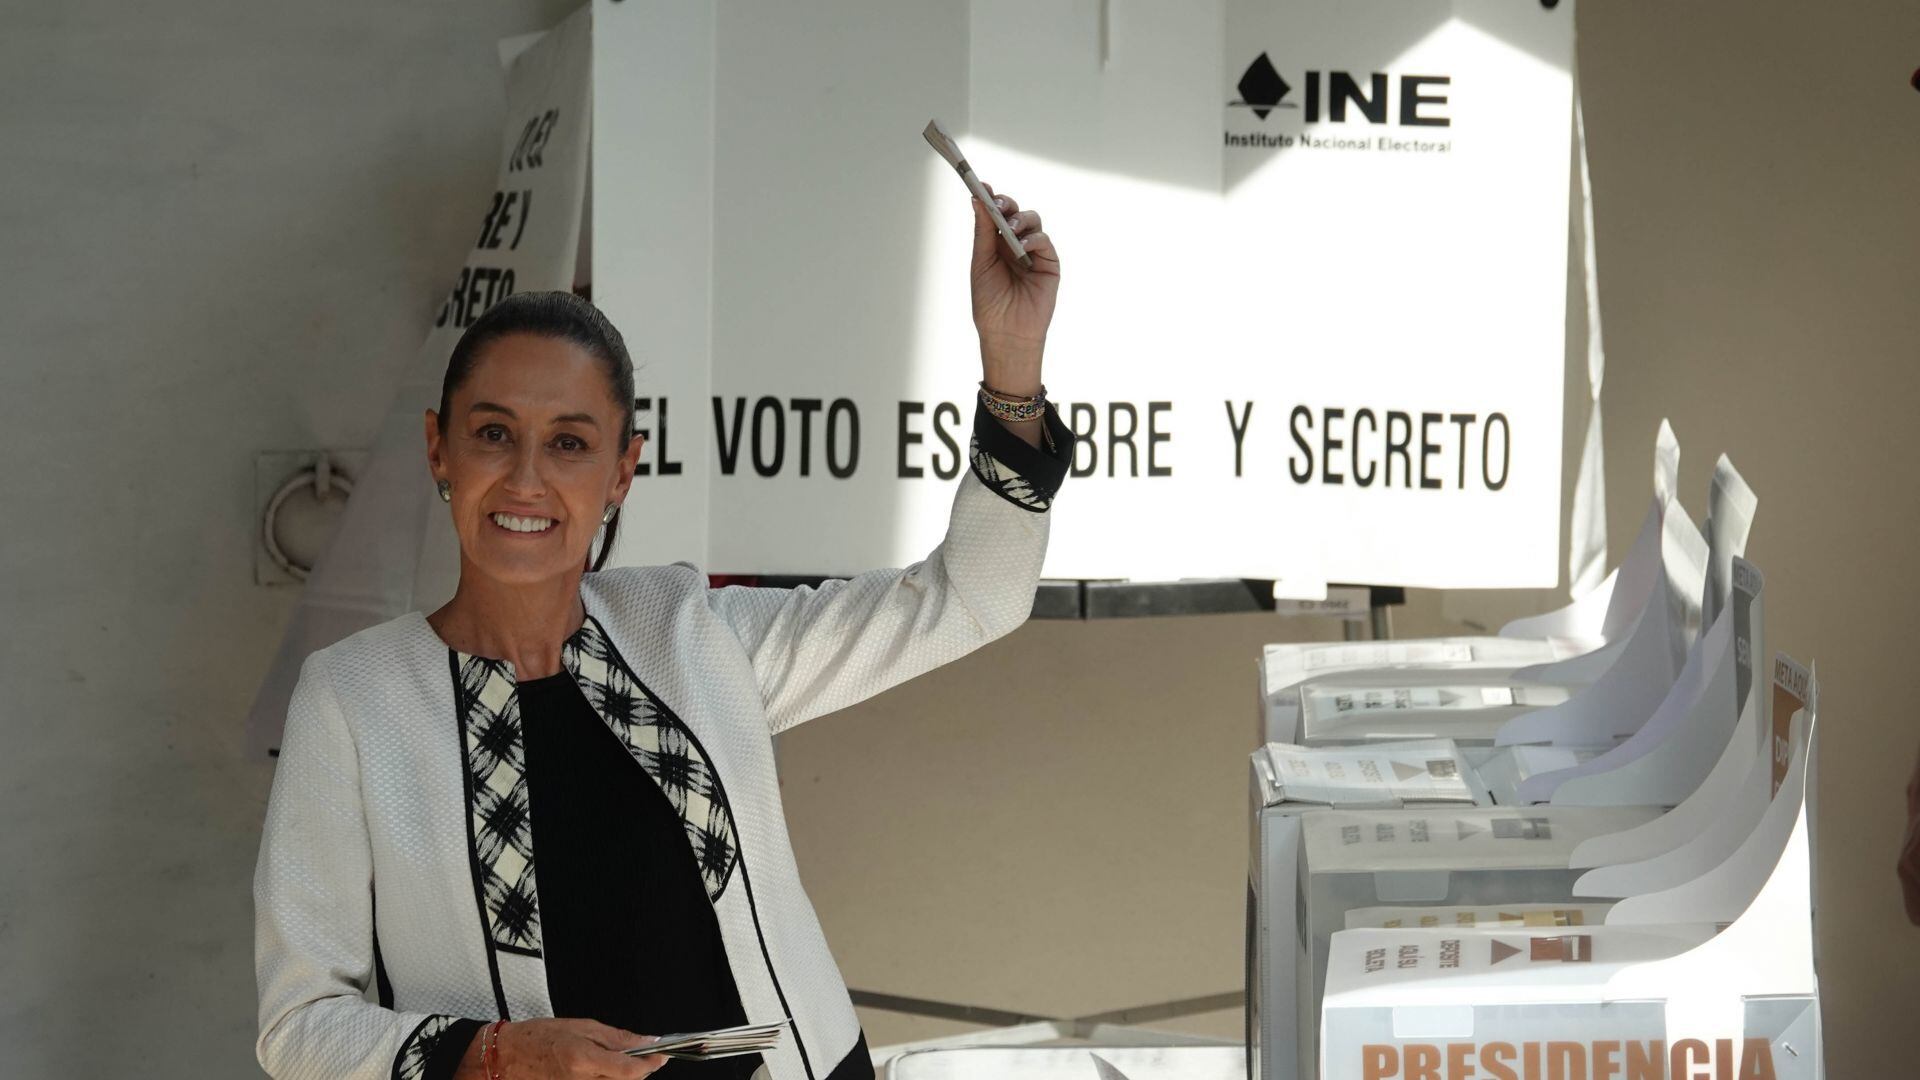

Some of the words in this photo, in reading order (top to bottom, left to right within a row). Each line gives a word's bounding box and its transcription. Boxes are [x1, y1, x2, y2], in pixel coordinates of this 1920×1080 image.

[1304, 70, 1451, 128] INE
[1224, 131, 1294, 148] Instituto
[1300, 134, 1372, 151] Nacional
[1378, 136, 1451, 153] Electoral
[711, 396, 861, 480] VOTO
[896, 400, 962, 481] ES
[1224, 400, 1254, 478] Y
[1288, 402, 1511, 492] SECRETO
[1774, 658, 1793, 691] META
[1364, 948, 1387, 974] BOLETA
[1398, 958, 1419, 969] SU
[1438, 939, 1461, 970] DEPOSITE
[1362, 1038, 1777, 1080] PRESIDENCIA
